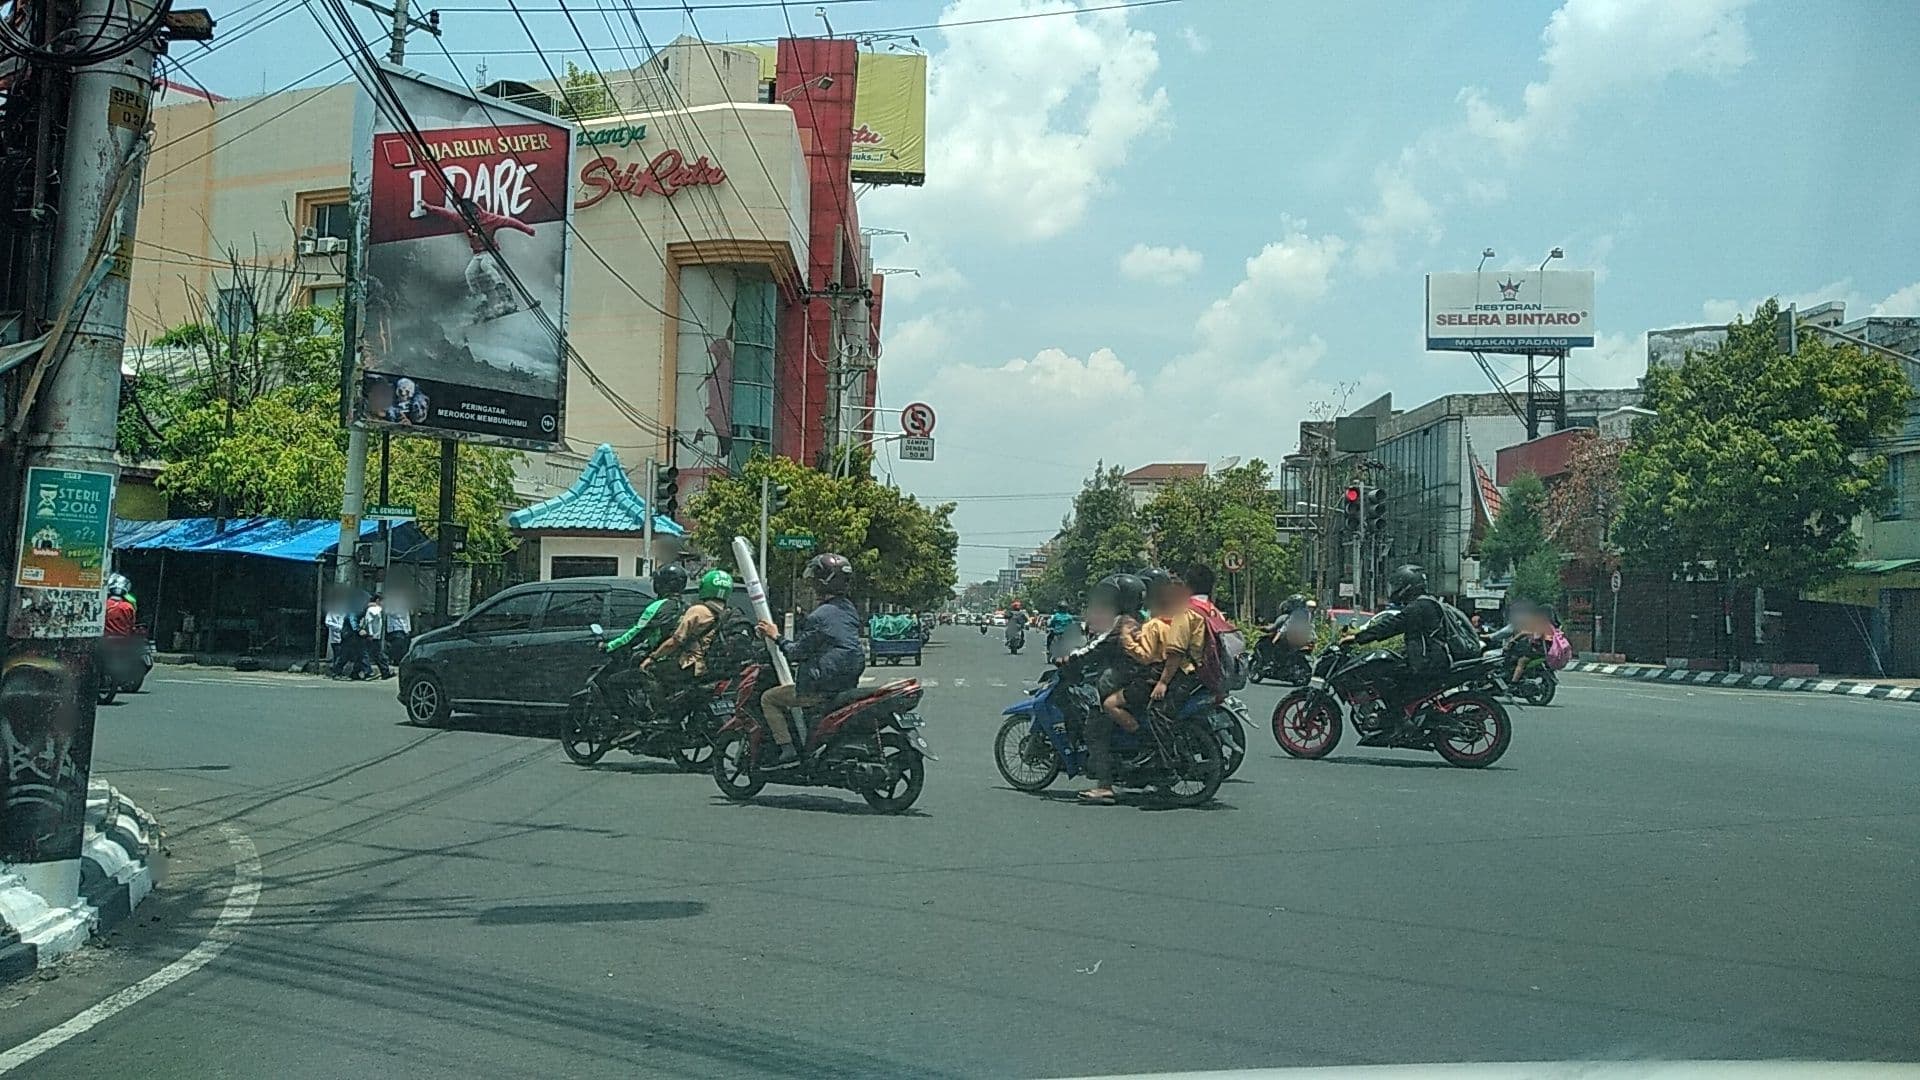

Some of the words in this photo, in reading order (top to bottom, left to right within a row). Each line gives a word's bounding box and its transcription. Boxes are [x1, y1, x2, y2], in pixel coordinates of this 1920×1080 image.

[417, 139, 496, 161] DJARUM
[498, 133, 552, 153] SUPER
[574, 156, 638, 209] Sri
[632, 148, 727, 197] Ratu
[409, 169, 427, 219] I
[441, 158, 538, 218] DARE
[1475, 303, 1542, 312] RESTORAN
[1436, 313, 1501, 326] SELERA
[1455, 338, 1516, 346] MASAKAN
[1517, 338, 1568, 346] PADANG
[437, 408, 475, 421] MEROKOK
[476, 414, 528, 428] MEMBUNUHMU
[58, 488, 101, 502] STERIL
[60, 501, 97, 514] 2018
